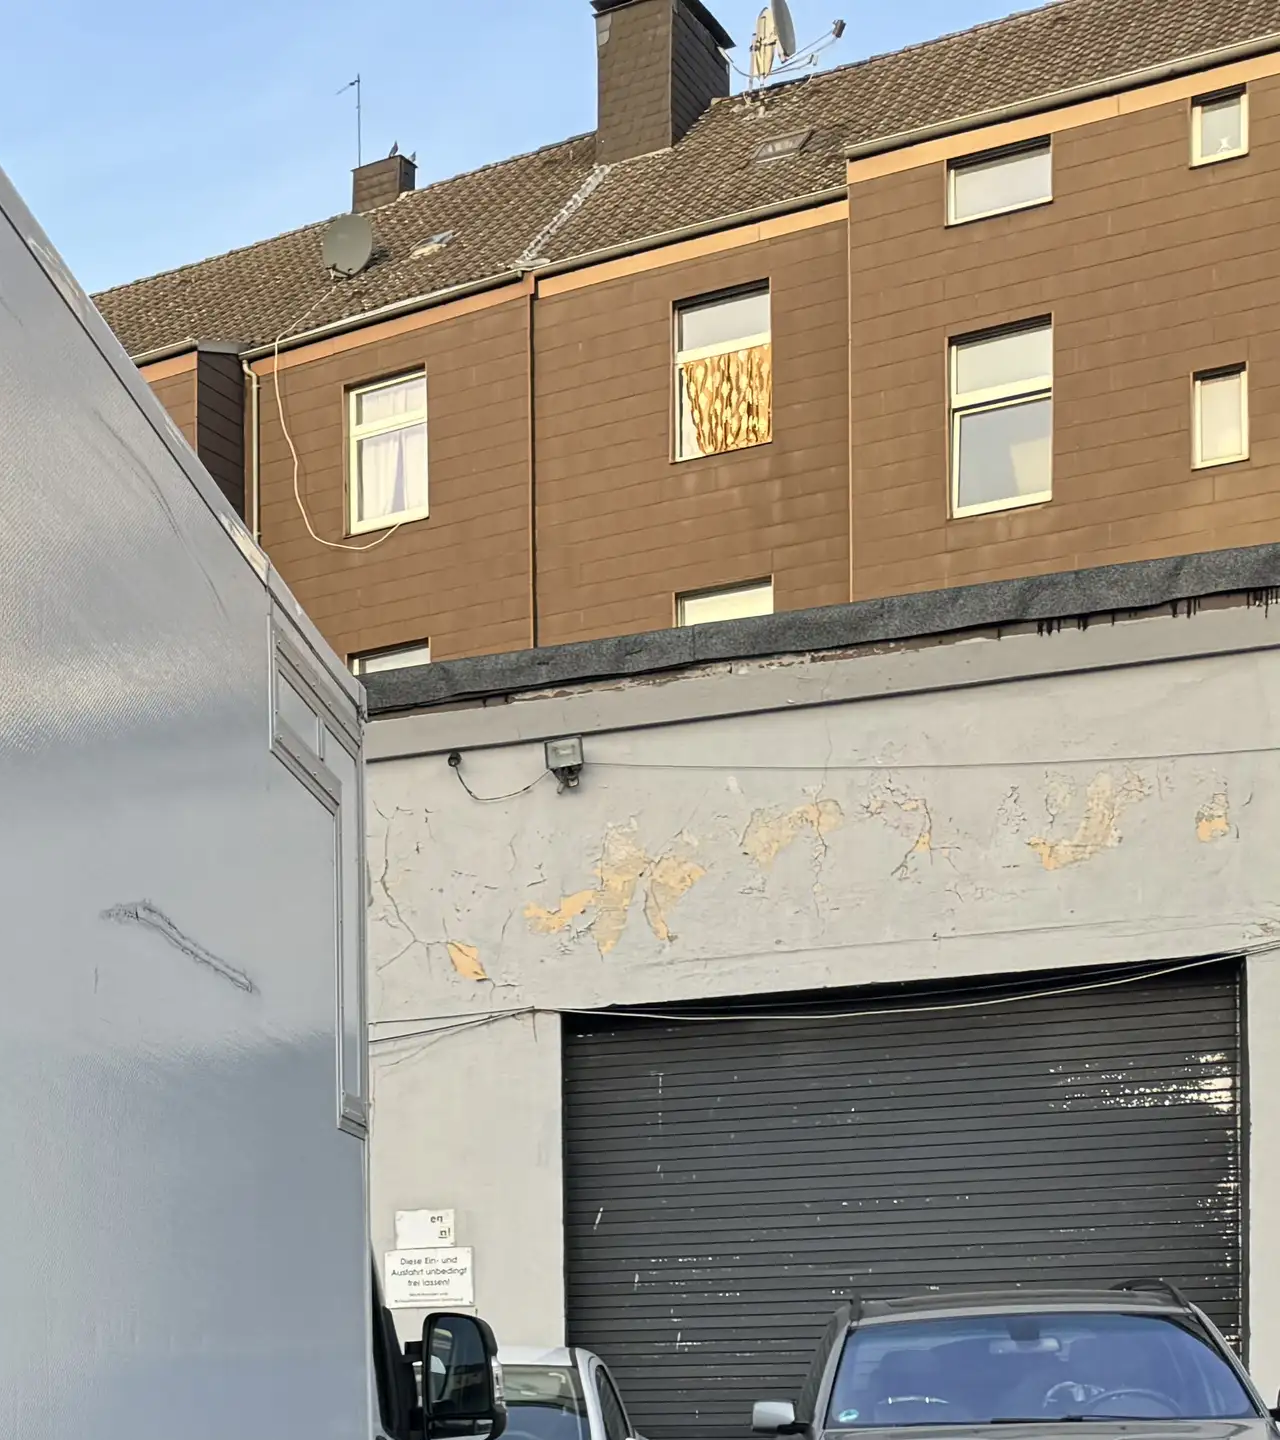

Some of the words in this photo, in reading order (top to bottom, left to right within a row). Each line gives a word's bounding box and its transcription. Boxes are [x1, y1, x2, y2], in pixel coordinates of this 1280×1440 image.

[400, 1257, 422, 1266] Diese
[441, 1256, 457, 1264] und
[391, 1268, 424, 1277] Ausfahrt
[426, 1266, 467, 1276] unbedingt
